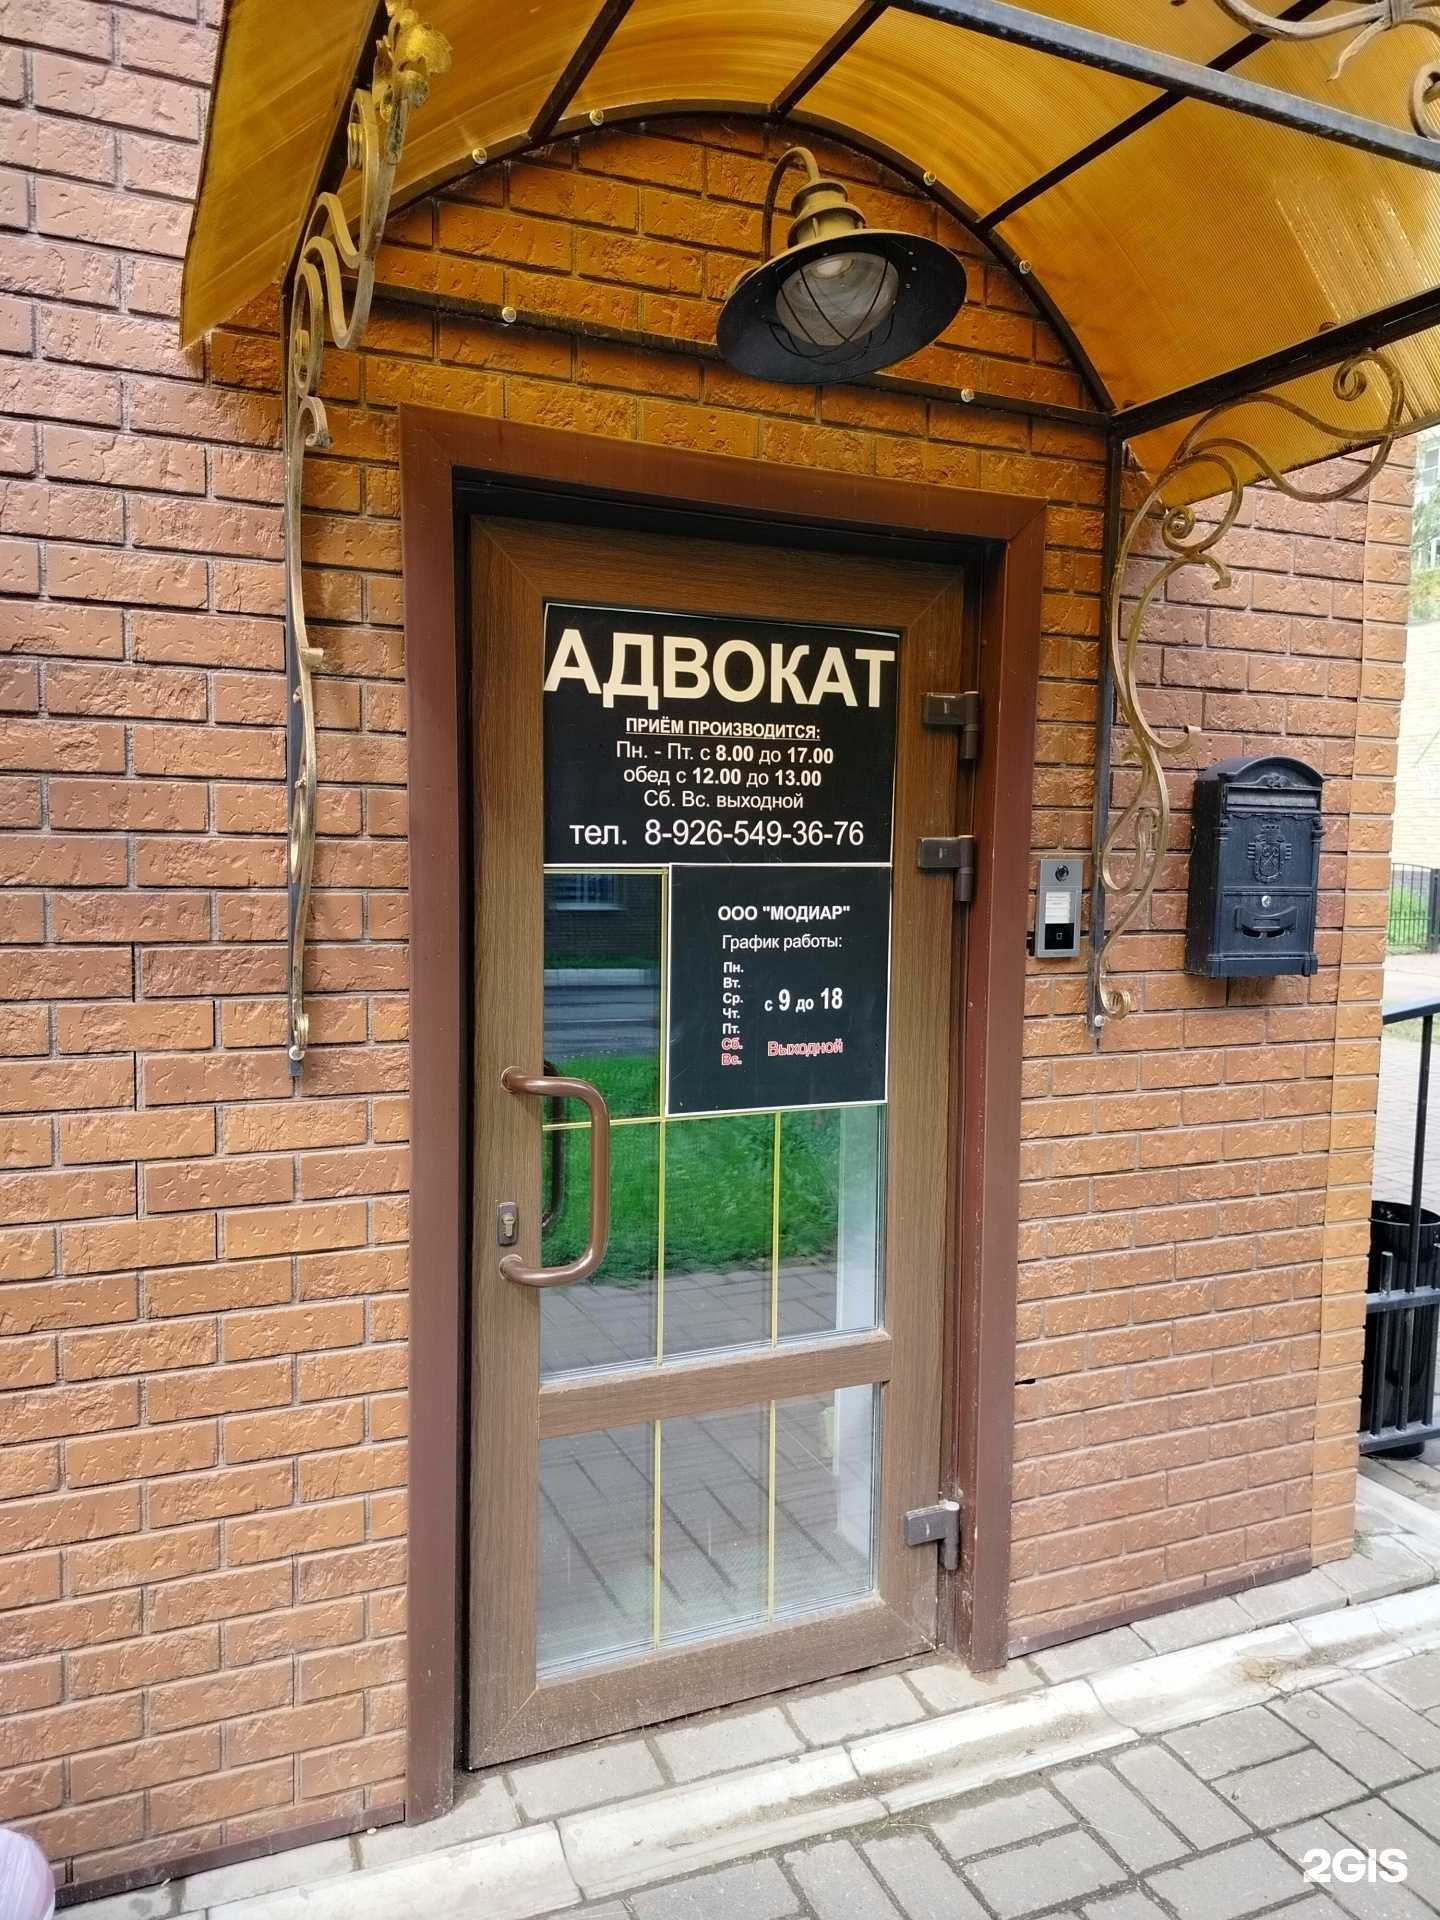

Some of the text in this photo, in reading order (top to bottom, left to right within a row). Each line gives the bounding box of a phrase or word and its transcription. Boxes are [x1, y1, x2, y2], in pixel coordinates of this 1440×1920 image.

[543, 628, 896, 711] АДВОКАТ
[625, 716, 821, 740] ПРИЁМ ПРОИЗВОДИТСЯ:
[616, 740, 648, 759] Пн.
[667, 742, 694, 761] Пт.
[700, 747, 711, 761] с
[715, 745, 754, 762] 8.00
[759, 749, 782, 765] до
[787, 747, 834, 764] 17.00
[623, 766, 822, 788] обед с 12.00 до 13.00
[644, 789, 804, 812] Сб. Вс. выходной
[569, 819, 864, 846] тел. 8-926-549-36-76
[718, 905, 851, 922] ООО "МОДИАР"
[722, 933, 842, 952] График работы:
[723, 961, 744, 974] Пн.
[723, 977, 741, 989] Вт.
[722, 992, 744, 1006] Ср.
[764, 987, 843, 1013] с 9 до 18
[722, 1008, 740, 1019] Чт.
[722, 1023, 740, 1035] Пт.
[721, 1037, 743, 1050] Сб.
[768, 1038, 843, 1057] Выходной
[721, 1053, 742, 1066] Вс.
